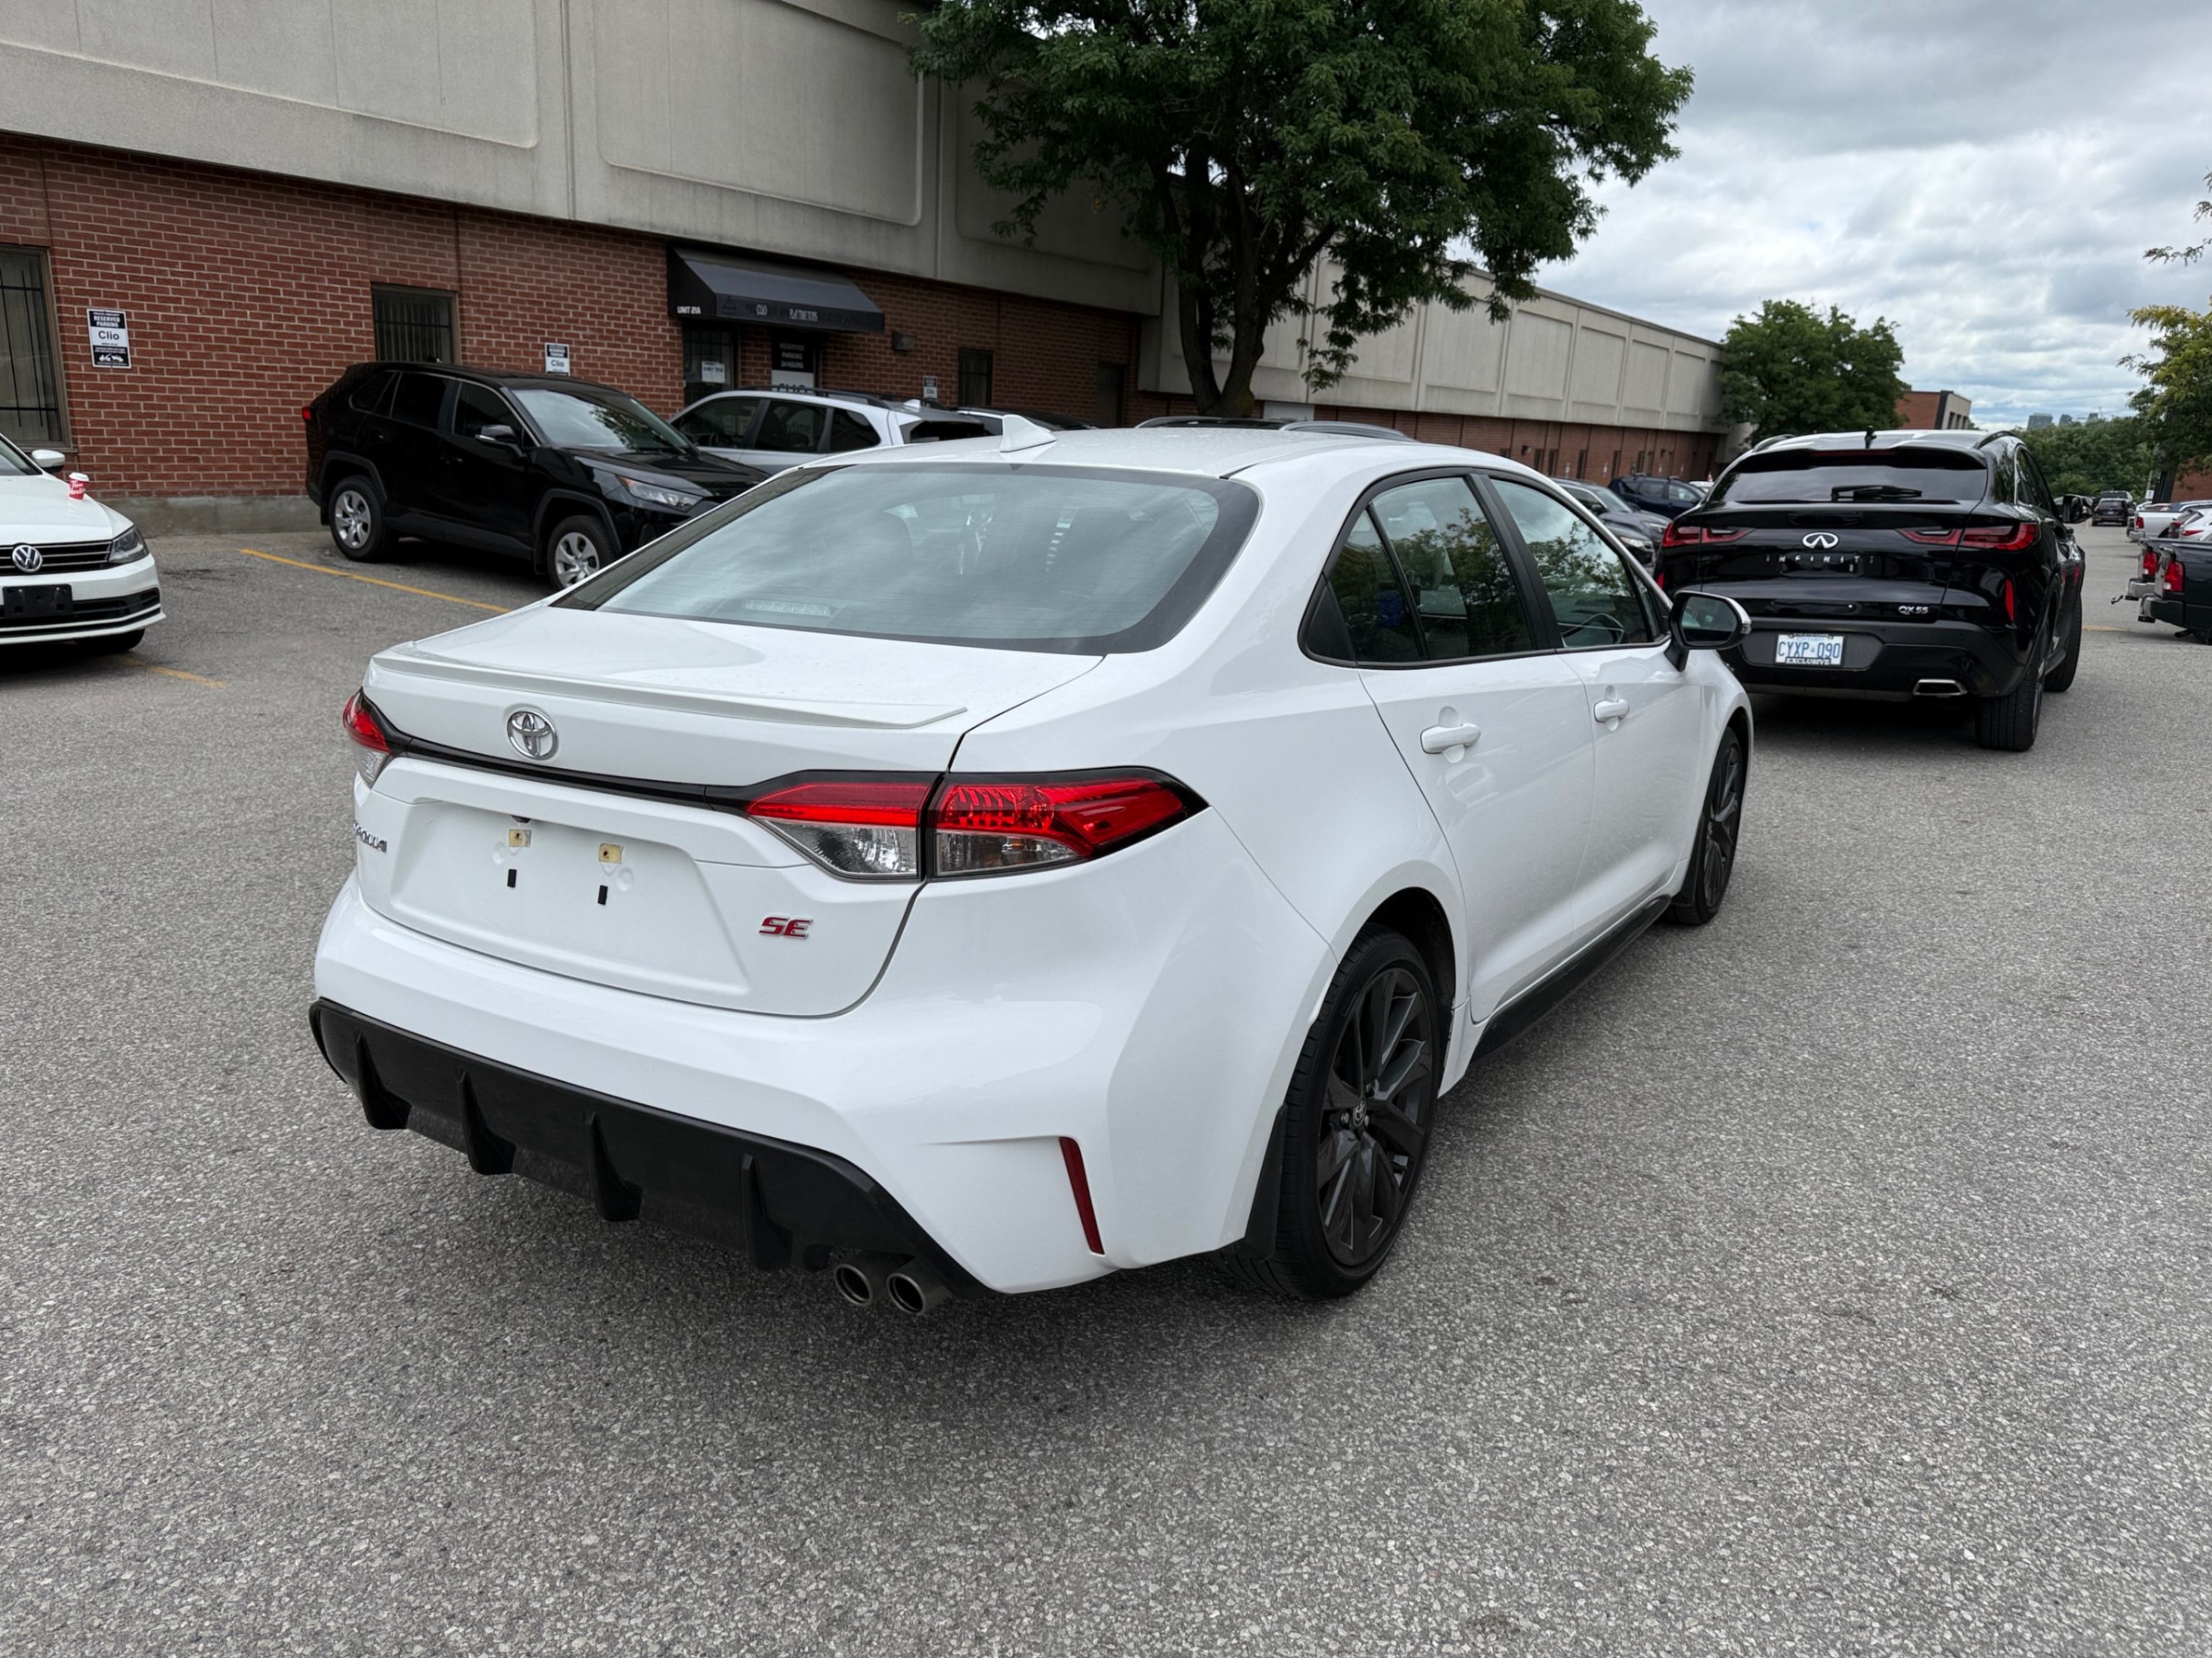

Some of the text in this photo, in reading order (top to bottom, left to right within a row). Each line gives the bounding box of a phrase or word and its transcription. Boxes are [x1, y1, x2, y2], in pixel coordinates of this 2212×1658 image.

[98, 330, 120, 340] Clio
[779, 342, 805, 351] RESERVED
[782, 351, 802, 360] PARKING
[1766, 555, 1874, 564] INFINITI
[758, 916, 813, 939] SE
